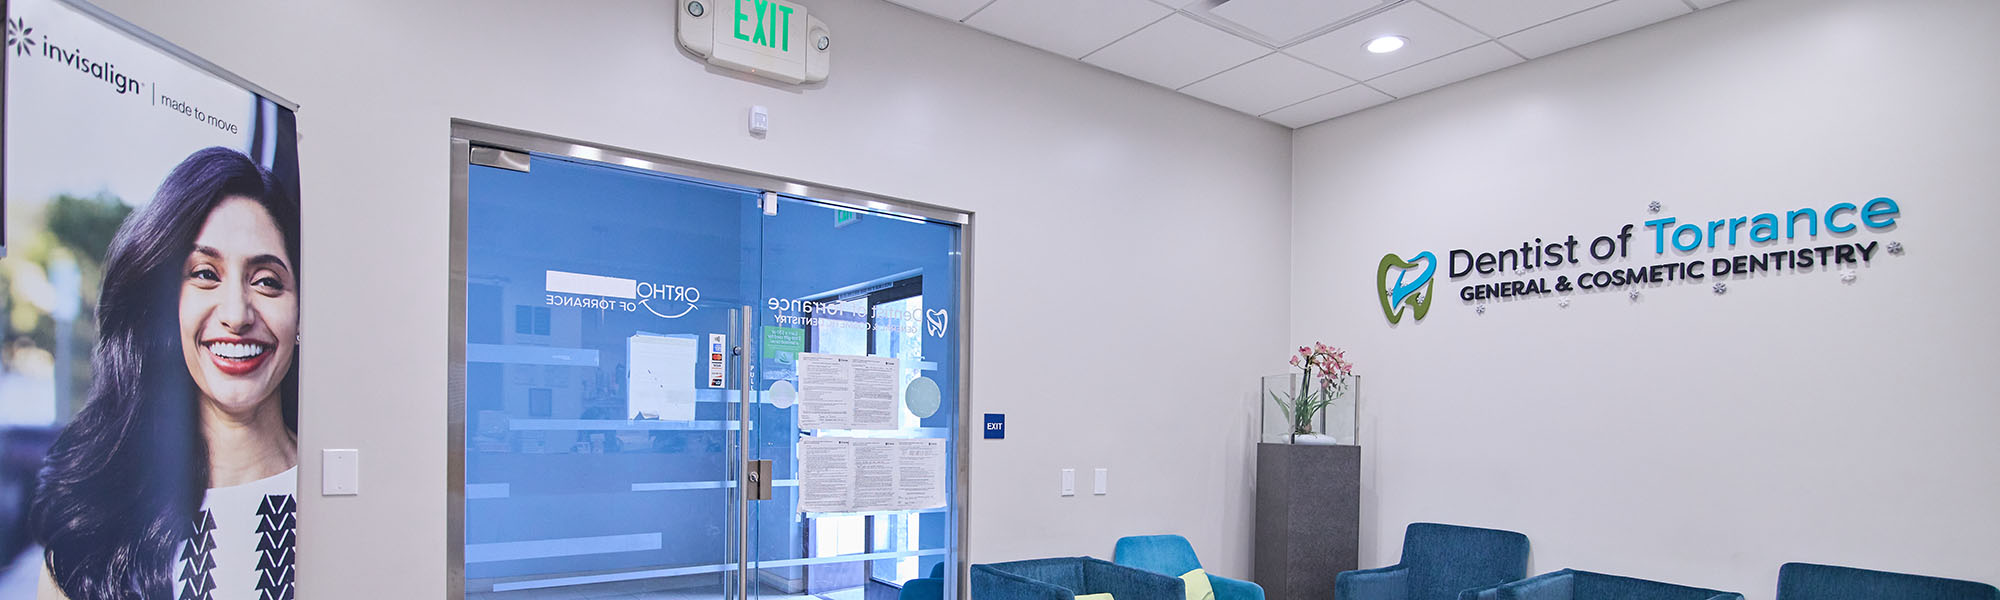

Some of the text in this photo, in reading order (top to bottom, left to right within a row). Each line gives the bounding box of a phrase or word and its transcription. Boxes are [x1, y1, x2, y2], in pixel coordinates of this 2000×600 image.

[733, 0, 794, 52] EXIT
[43, 35, 139, 94] invisalign
[161, 94, 238, 134] made to move
[1450, 197, 1900, 278] Dentist of Torrance
[1460, 241, 1878, 301] GENERAL & COSMETIC DENTISTRY
